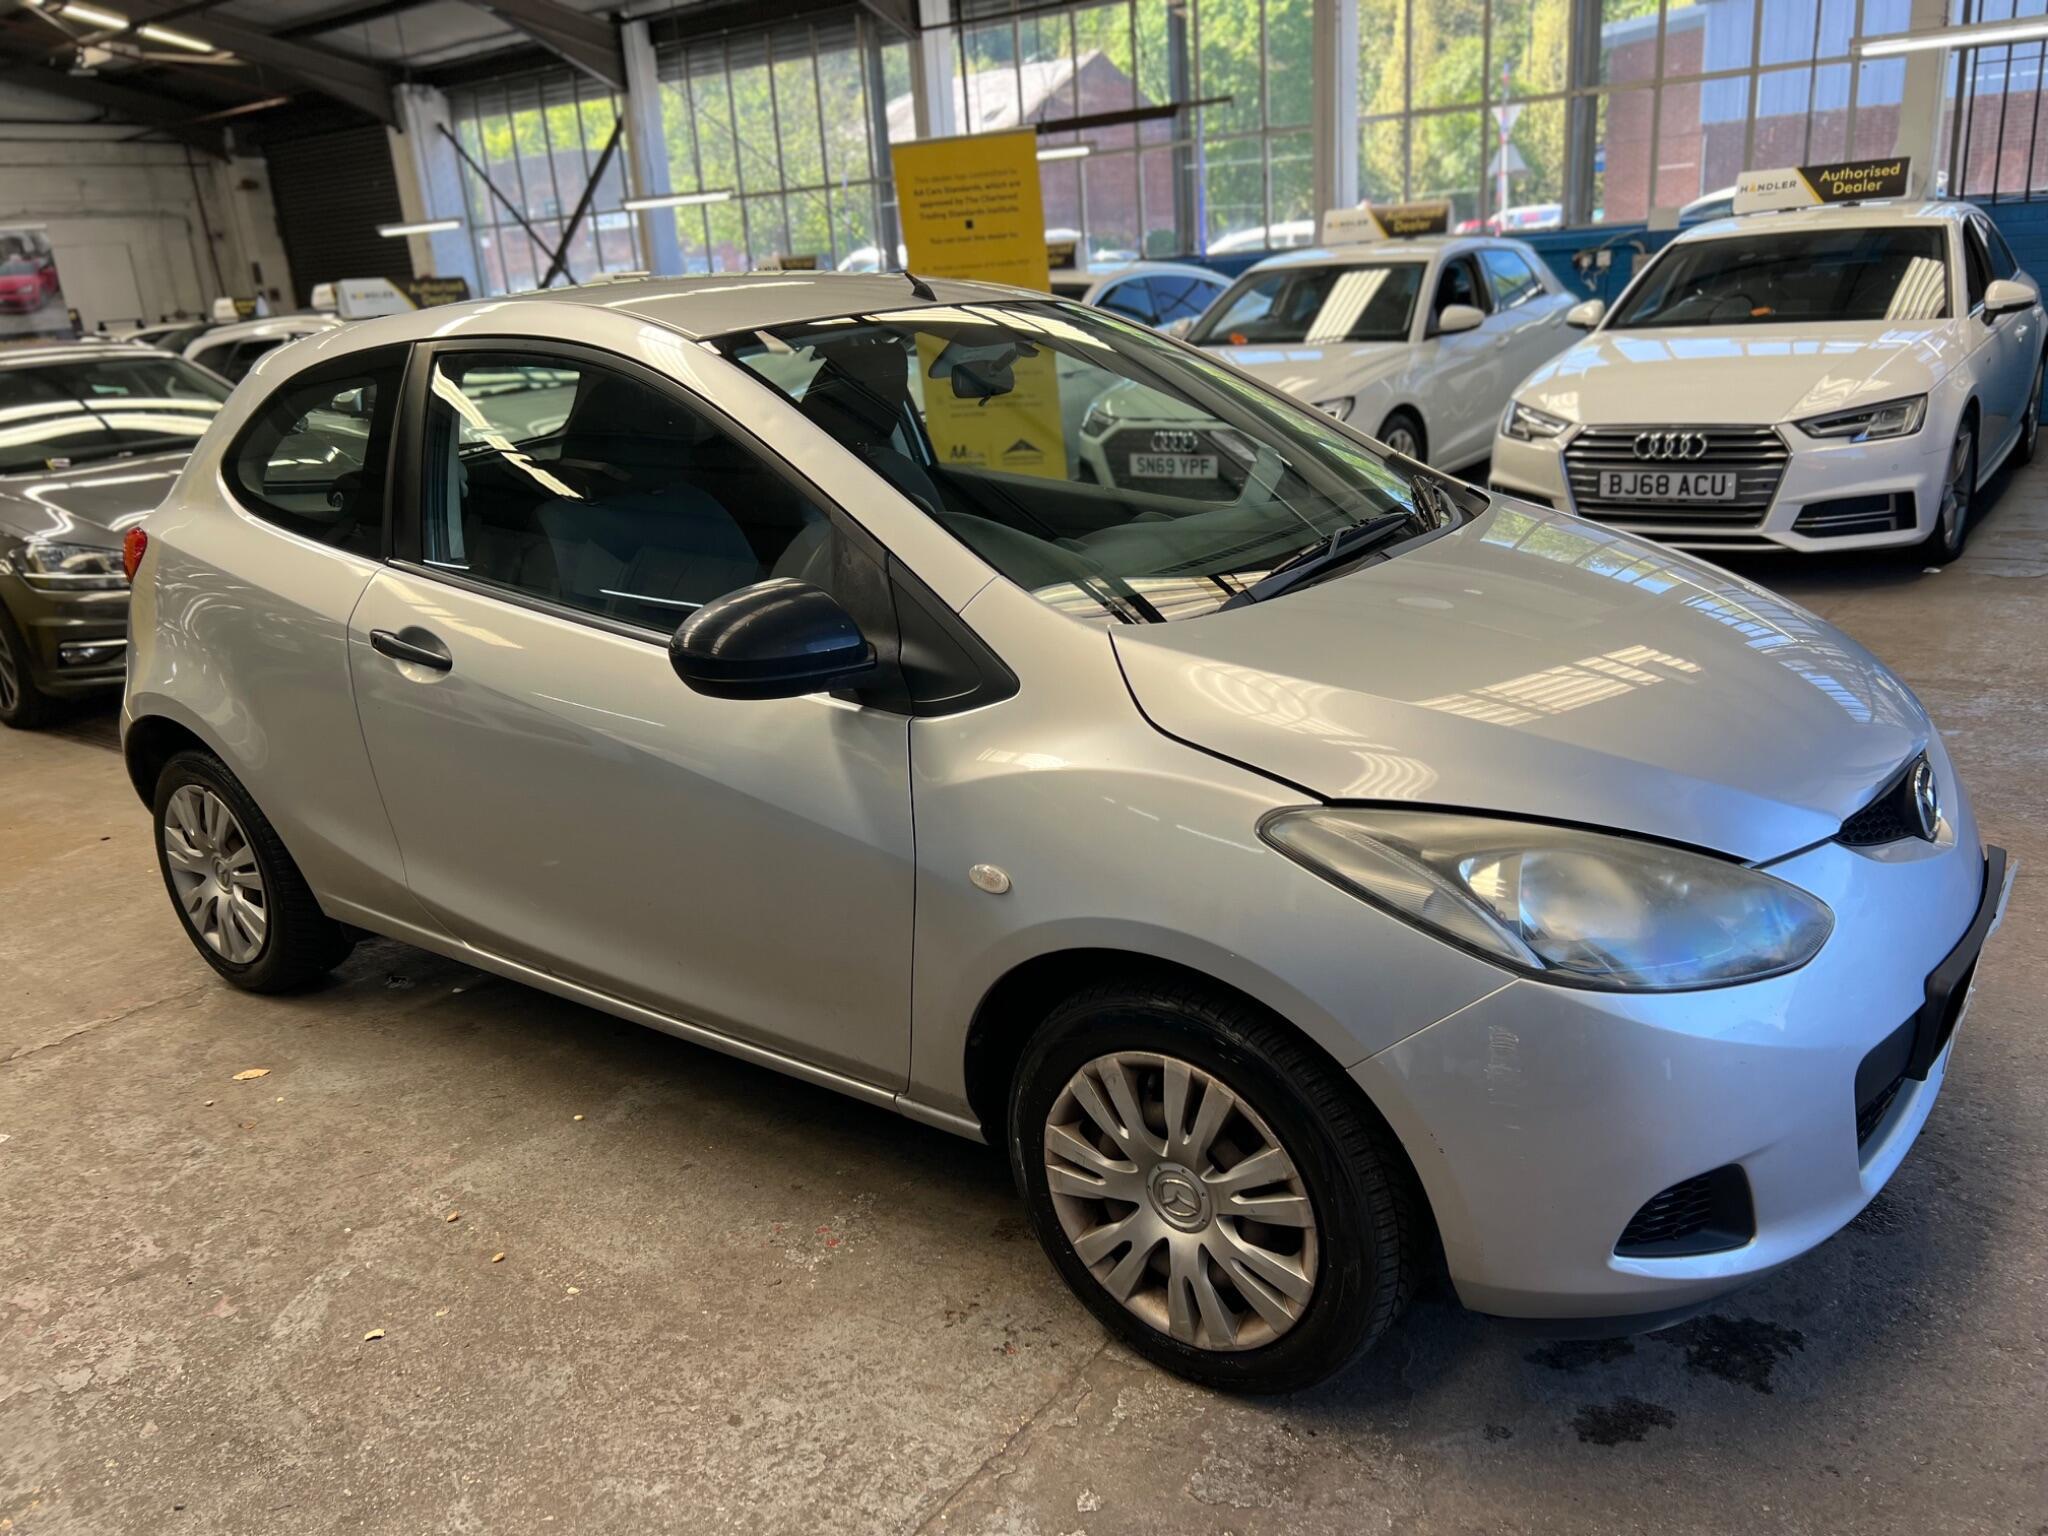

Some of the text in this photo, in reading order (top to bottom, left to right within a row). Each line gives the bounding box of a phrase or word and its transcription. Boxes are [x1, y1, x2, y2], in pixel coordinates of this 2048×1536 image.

[1820, 163, 1901, 183] Authorised
[1833, 180, 1883, 195] Dealer
[1136, 457, 1210, 475] SN69 YPF
[1608, 473, 1727, 497] BJ68 ACU
